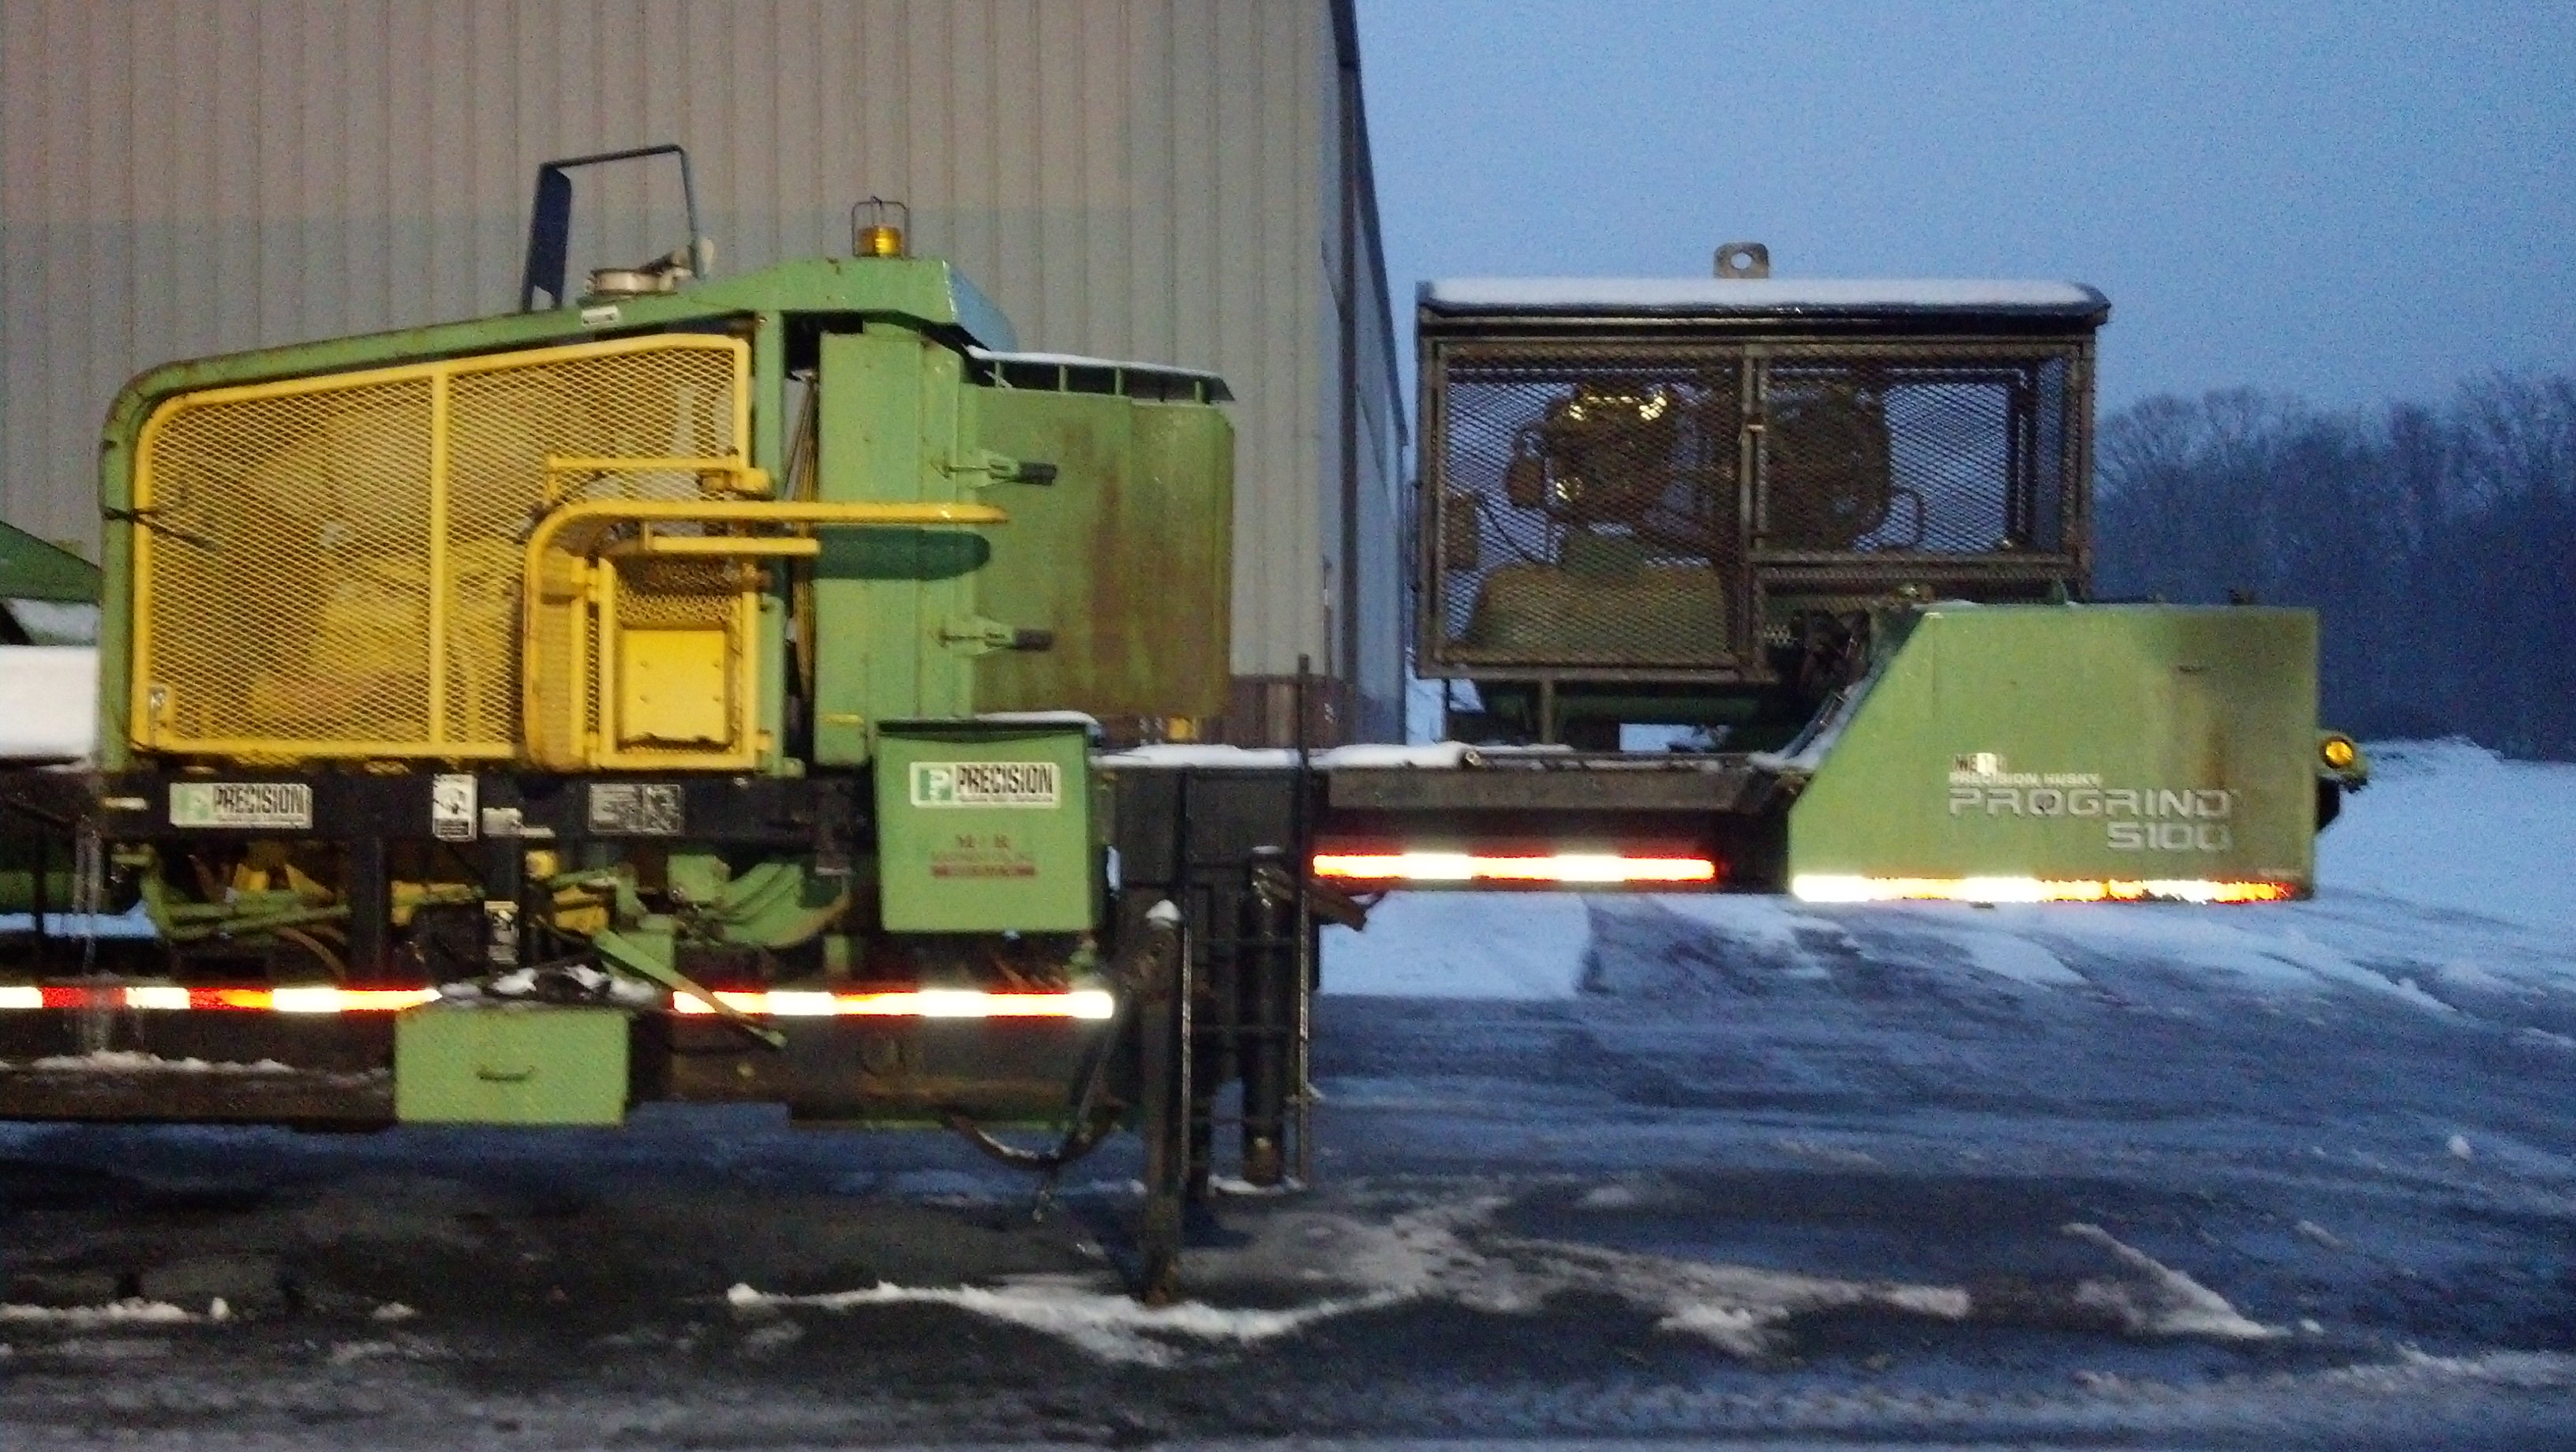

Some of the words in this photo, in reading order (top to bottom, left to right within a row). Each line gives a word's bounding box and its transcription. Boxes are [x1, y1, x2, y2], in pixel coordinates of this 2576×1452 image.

[956, 764, 1053, 794] PRECISION
[213, 784, 305, 814] PRECISION
[1949, 788, 2230, 817] PROGRIND
